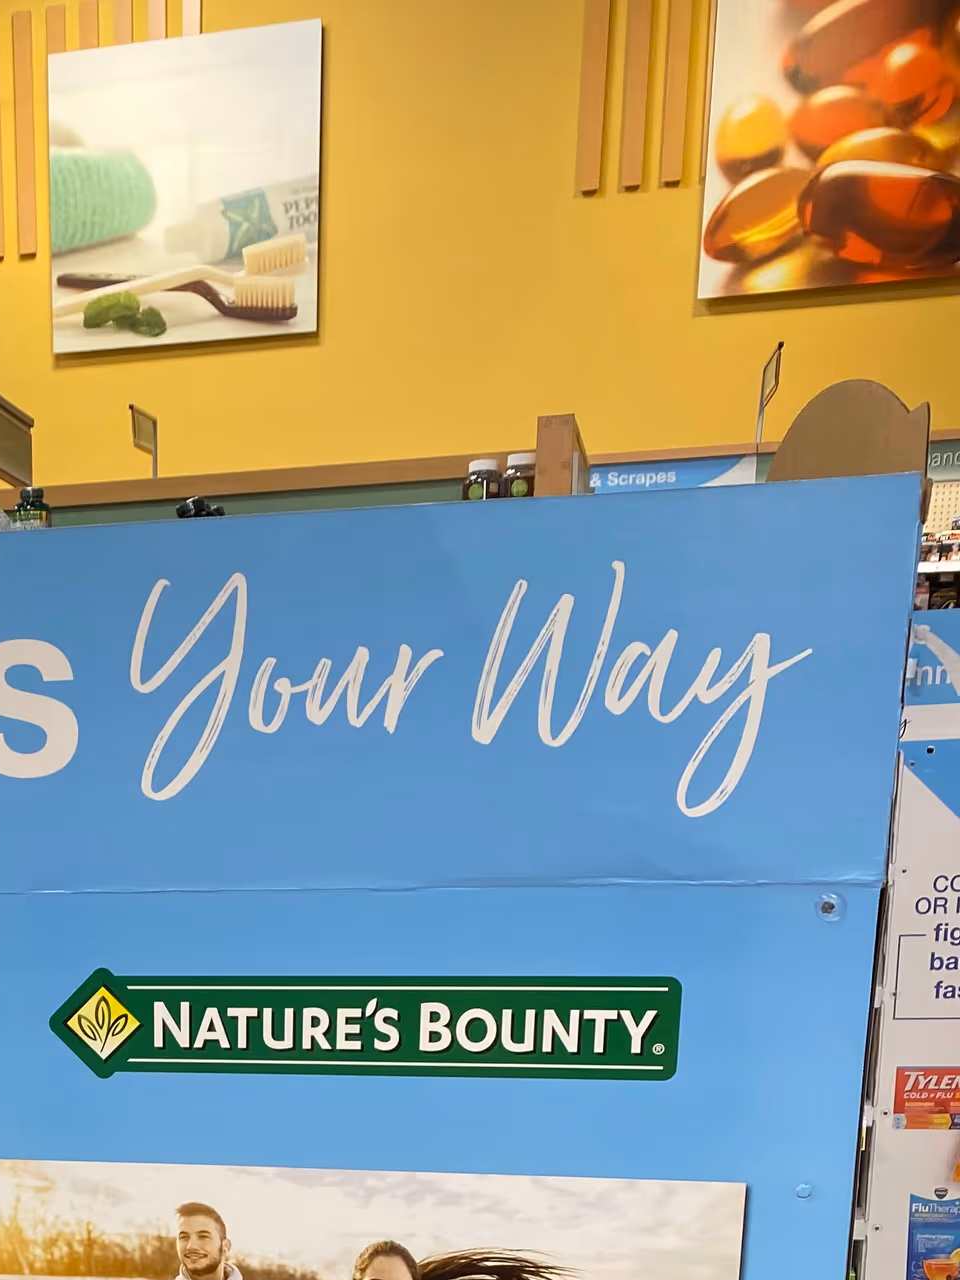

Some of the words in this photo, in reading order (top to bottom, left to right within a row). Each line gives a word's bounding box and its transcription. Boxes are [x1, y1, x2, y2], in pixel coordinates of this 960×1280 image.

[589, 472, 601, 487] &
[607, 469, 677, 489] Scrapes
[130, 572, 444, 801] Your
[471, 561, 813, 817] Way
[933, 875, 960, 893] CO
[915, 897, 948, 915] OR
[152, 996, 401, 1054] NATURE'S
[419, 1001, 660, 1056] BOUNTY
